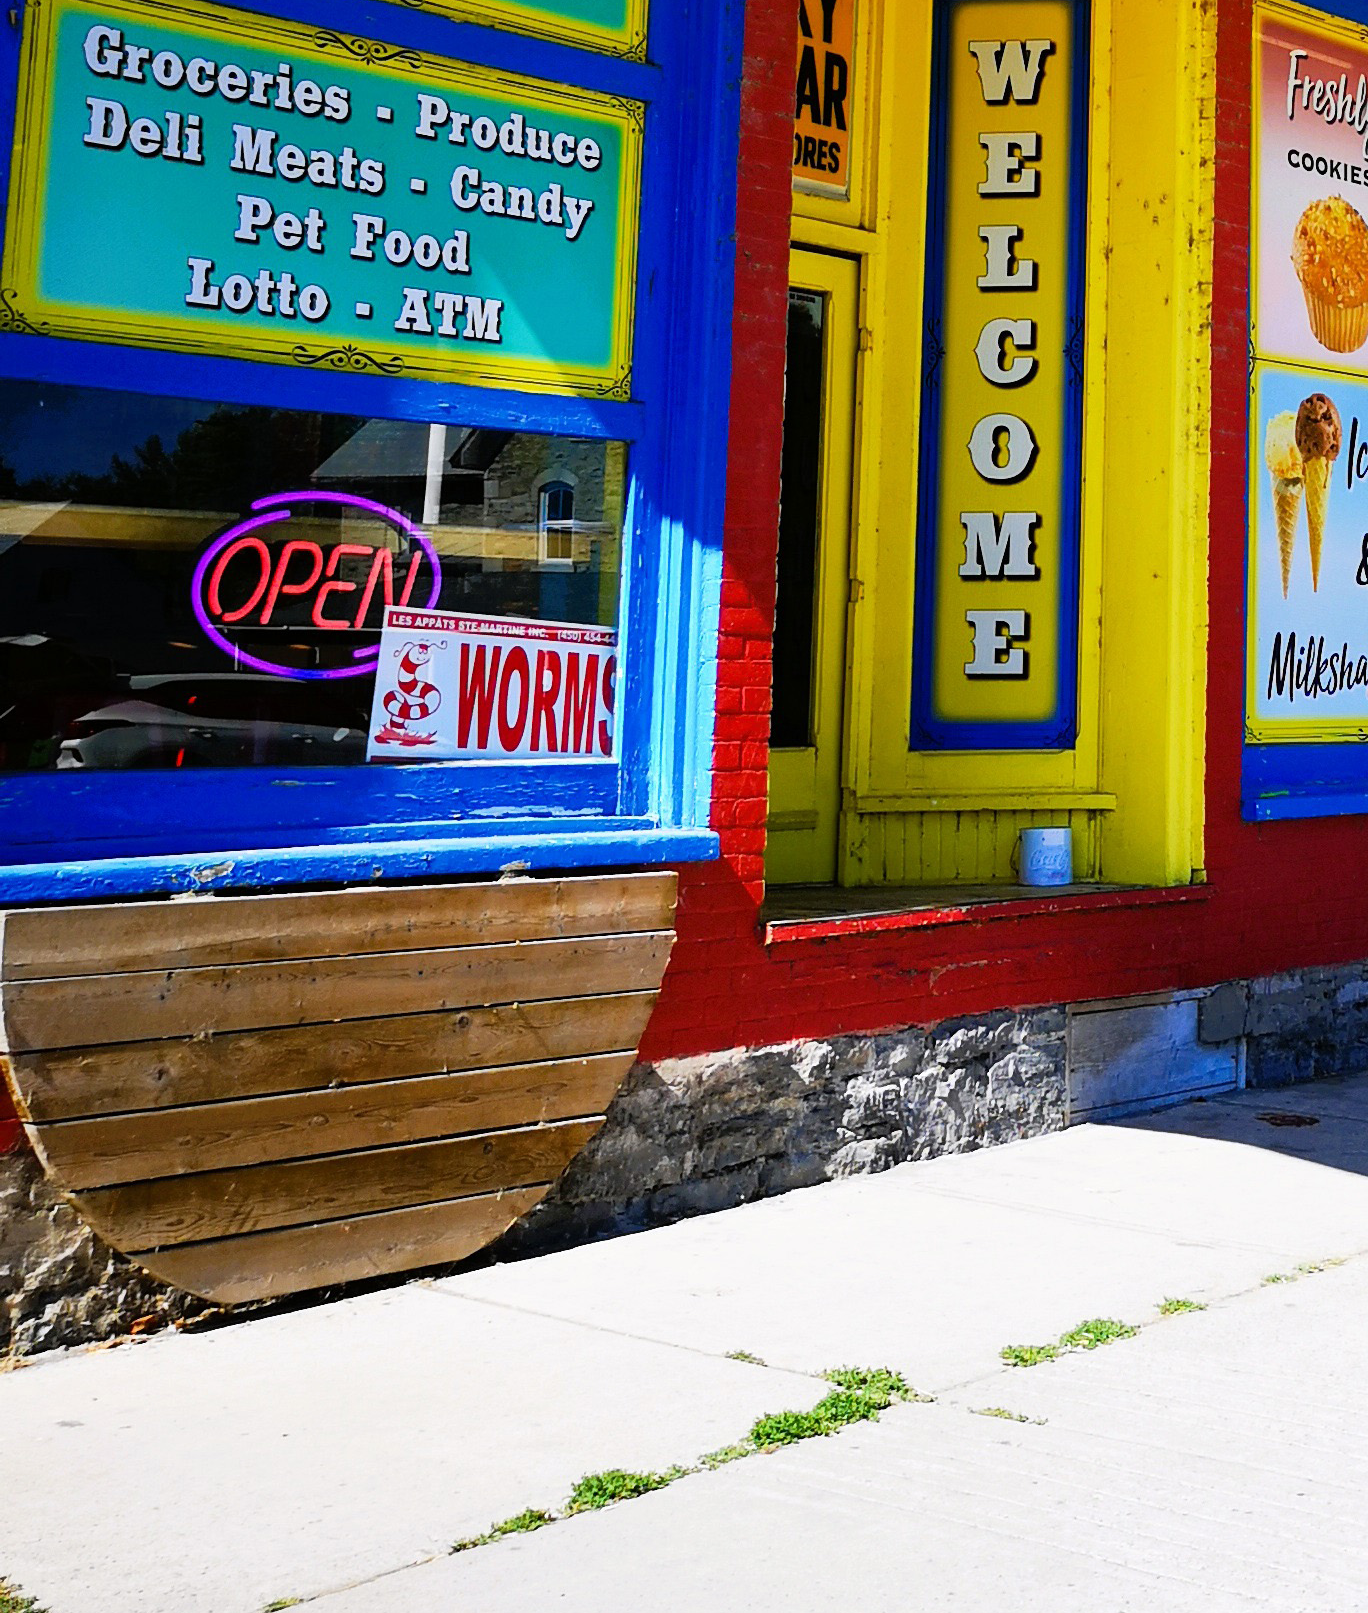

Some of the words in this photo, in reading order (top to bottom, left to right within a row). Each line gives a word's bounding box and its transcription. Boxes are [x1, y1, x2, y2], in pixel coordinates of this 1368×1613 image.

[83, 25, 351, 123] Groceries
[415, 94, 602, 171] Produce
[83, 97, 204, 164] Deli
[231, 125, 385, 195] Meats
[450, 166, 594, 241] Candy
[234, 193, 325, 253] Pet
[350, 213, 471, 275] Food
[186, 258, 330, 322] Lotto
[394, 289, 503, 344] ATM
[957, 38, 1056, 683] WELCOME
[209, 537, 422, 628] OPEN
[391, 614, 413, 627] LES
[456, 642, 618, 759] WORMS
